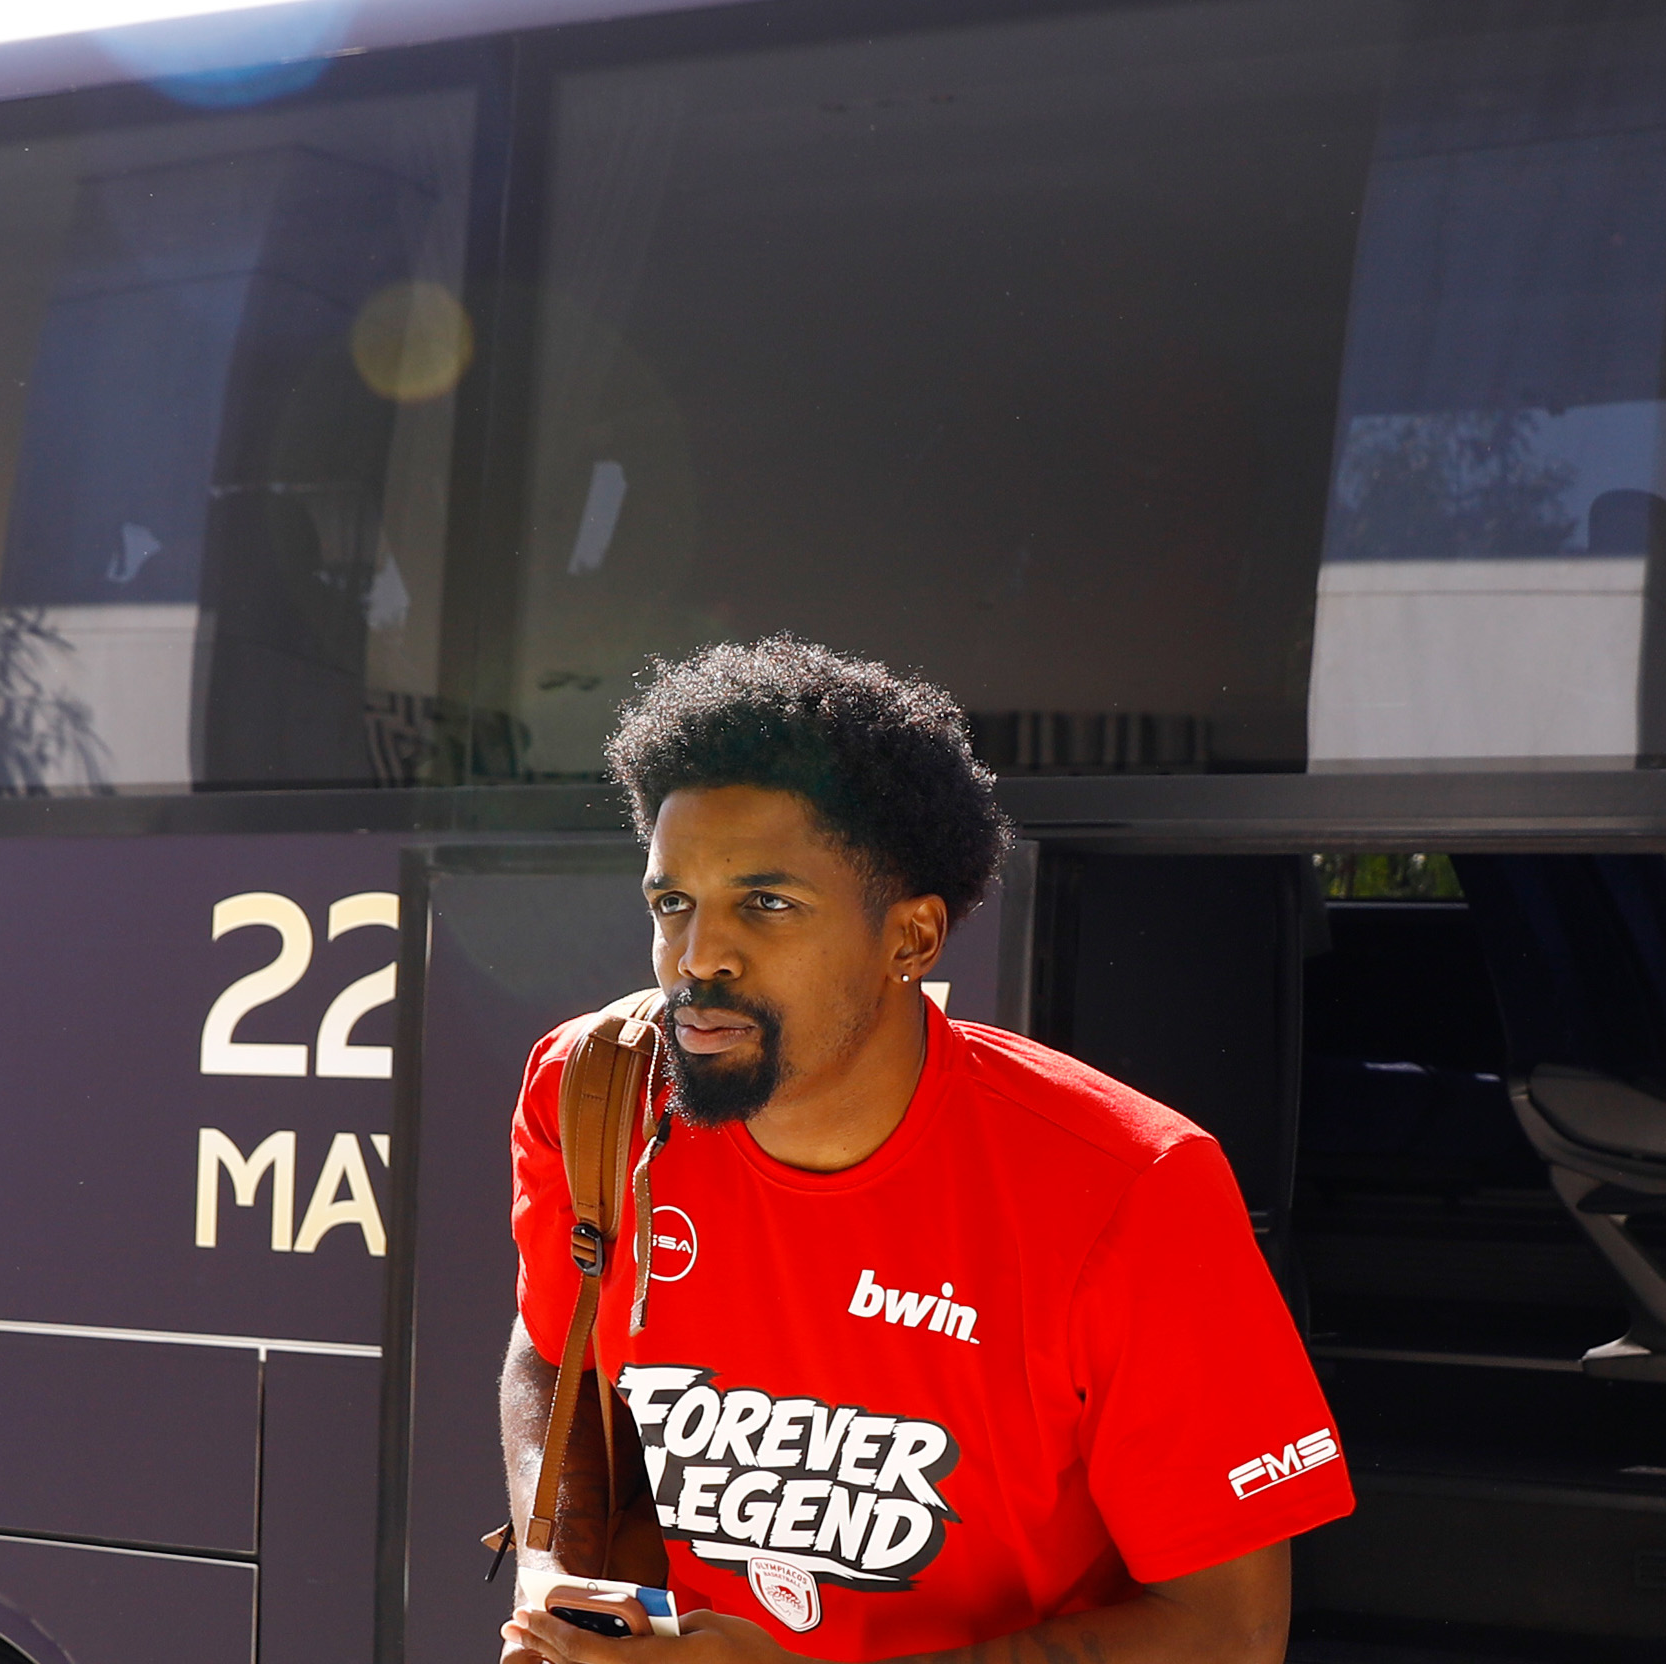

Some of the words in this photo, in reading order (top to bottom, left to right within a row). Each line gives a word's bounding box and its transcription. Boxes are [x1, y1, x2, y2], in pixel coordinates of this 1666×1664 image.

[199, 891, 399, 1079] 22
[195, 1127, 391, 1257] MA
[652, 1234, 692, 1254] SA
[617, 1366, 949, 1512] FOREVER
[1228, 1427, 1337, 1497] FMS
[754, 1561, 808, 1585] OLYMPIACOS
